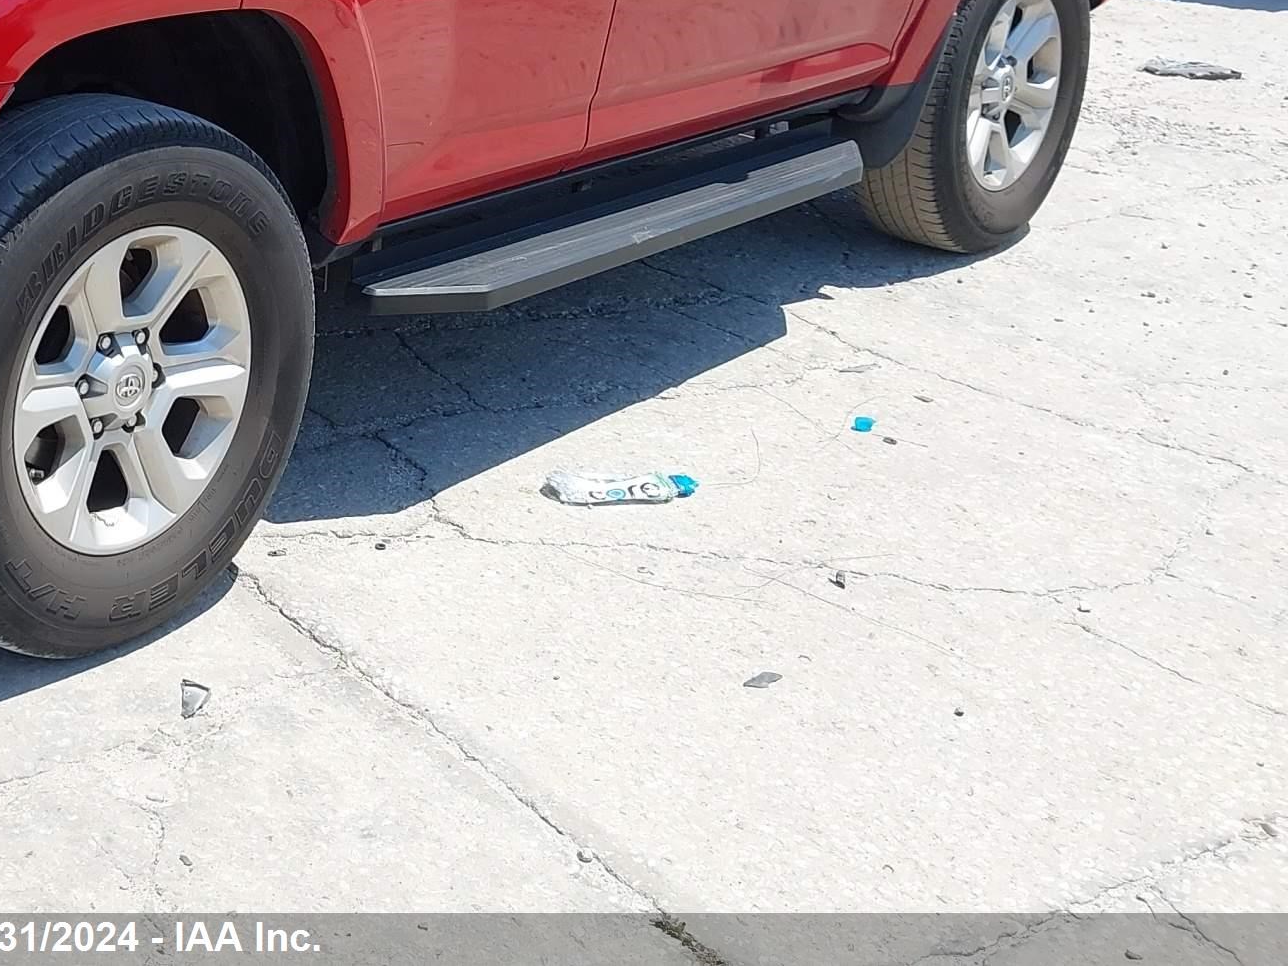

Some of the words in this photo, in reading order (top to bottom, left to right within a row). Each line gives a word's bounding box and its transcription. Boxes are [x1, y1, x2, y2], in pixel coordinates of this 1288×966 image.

[15, 172, 271, 318] BRIDGESTONE
[108, 431, 284, 622] DUELER
[588, 481, 661, 501] core
